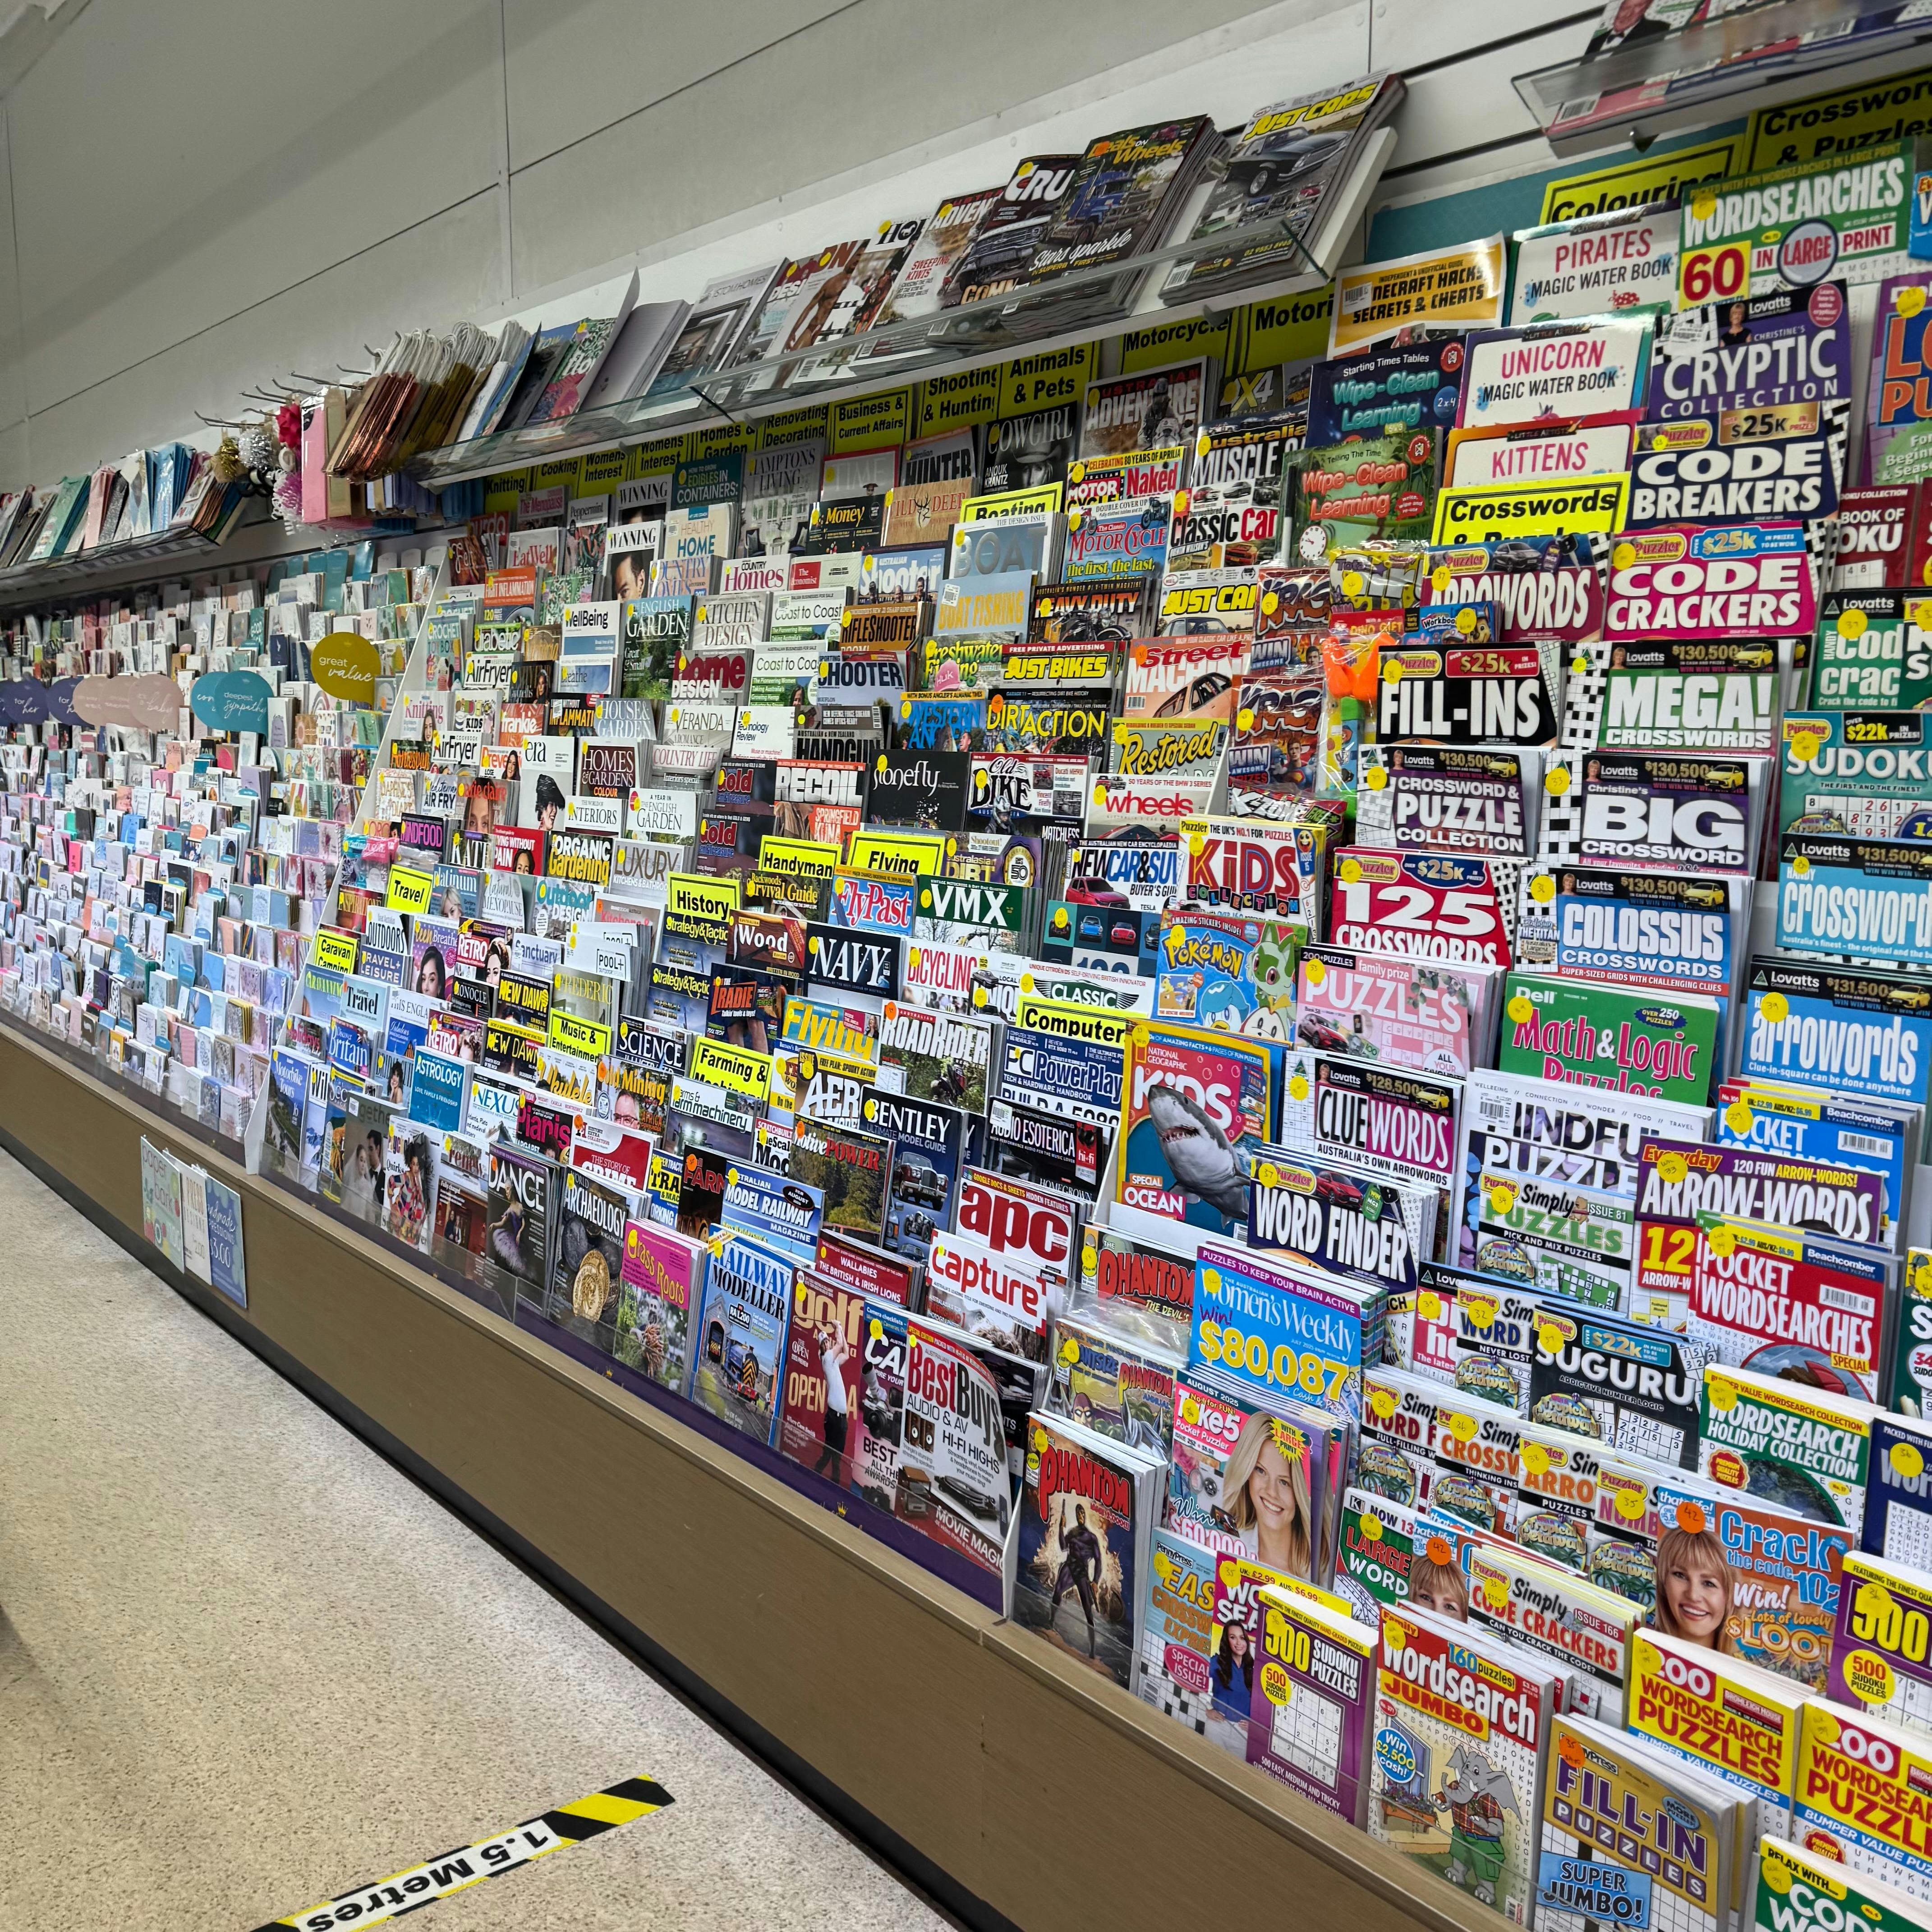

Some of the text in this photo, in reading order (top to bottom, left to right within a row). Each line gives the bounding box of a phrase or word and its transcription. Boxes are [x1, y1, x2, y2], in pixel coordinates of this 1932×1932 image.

[1244, 83, 1378, 140] JUST CARS
[1113, 138, 1186, 165] Wheels
[1685, 161, 1904, 248] WORDSEARCHES
[1555, 229, 1653, 273] PIRATES
[1009, 346, 1085, 378] Animals
[1343, 353, 1430, 378] Starting Times Tables
[1501, 340, 1606, 379] UNICORN
[1663, 329, 1836, 401] CRYPTIC
[1014, 377, 1075, 403] & Pets
[1334, 369, 1440, 405] Wipe-Clean
[1661, 378, 1838, 418] COLLECTION
[839, 397, 902, 420] Business &
[1342, 401, 1420, 432] Learning
[767, 424, 826, 445] Decorating
[839, 419, 903, 439] Current Affairs
[541, 459, 578, 476] Cooking
[584, 463, 622, 483] Interest
[1492, 442, 1588, 478] KITTENS
[1637, 442, 1824, 485] CODE
[487, 477, 525, 494] Knitting
[1127, 463, 1178, 495] Naked
[1302, 460, 1408, 494] Wipe-Clean
[1310, 492, 1389, 520] Learning
[1449, 490, 1616, 523] Crosswords
[1633, 477, 1822, 520] BREAKERS
[681, 520, 714, 535] HEALTHY
[826, 507, 864, 525] Money
[1840, 508, 1905, 524] BOOK OF
[678, 535, 715, 557] HOME
[1612, 558, 1802, 597] CODE
[1607, 592, 1800, 631] CRACKERS
[1843, 598, 1894, 612] Lovatts
[320, 657, 348, 669] great
[1051, 655, 1107, 679] BIKES
[1145, 641, 1245, 668] Street
[1460, 653, 1511, 674] $25k
[328, 667, 373, 682] value
[672, 680, 719, 698] DESIGN
[224, 691, 253, 701] deepest
[1380, 680, 1540, 737] FILL-INS
[1118, 722, 1217, 774] Restored
[1606, 729, 1771, 749] CROSSWORDS
[584, 749, 633, 772] HOMES
[424, 794, 455, 809] AIR FRY
[777, 767, 862, 804] RECOIL
[1105, 791, 1193, 816] wheels
[1398, 794, 1522, 835] PUZZLE
[1181, 821, 1207, 833] Puzzler
[1586, 792, 1745, 850] BIG
[555, 835, 611, 861] ORGANIC
[1397, 827, 1523, 852] COLLECTION
[1581, 839, 1744, 865] CROSSWORD
[764, 851, 832, 878] Handyman
[393, 879, 424, 904] Travel
[677, 890, 729, 921] History
[931, 883, 1009, 927] VMX
[1187, 884, 1299, 918] COLLECTION
[1338, 881, 1495, 936] 125
[739, 925, 788, 952] Wood
[1335, 925, 1497, 965] CROSSWORDS
[1564, 903, 1723, 961] COLOSSUS
[321, 939, 350, 960] Caravan
[810, 937, 892, 986] NAVY
[1562, 950, 1722, 979] CROSSWORDS
[1771, 971, 1820, 987] Lovatts
[347, 985, 378, 1015] Travel
[1052, 983, 1116, 1008] CLASSIC
[561, 1021, 596, 1044] Music &
[620, 1030, 682, 1067] SCIENCE
[700, 1049, 766, 1082] Farming &
[1147, 1055, 1187, 1071] GEOGRAPHIC
[1148, 1046, 1179, 1060] NATIONAL
[415, 1061, 462, 1088] ASTROLOGY
[1748, 1063, 1911, 1096] Clue-in-square can be done anywhere
[1827, 1107, 1895, 1127] Beachcomber
[1023, 1123, 1075, 1157] ESOTERICA
[1132, 1175, 1162, 1187] SPECIAL
[1734, 1159, 1857, 1187] 120 FUN ARROW-WORDS!
[488, 1172, 544, 1212] DANCE
[726, 1185, 813, 1228] MODEL RAILWAY
[1125, 1187, 1183, 1215] OCEAN
[1521, 1184, 1576, 1219] Simply
[563, 1183, 626, 1239] ARCHAEOLOGY
[960, 1185, 1068, 1262] apc
[770, 1223, 811, 1242] MAGAZINE
[1256, 1184, 1407, 1283] WORD FINDER
[1504, 1230, 1601, 1262] PICK AND MIX PUZZLES
[841, 1256, 877, 1279] WALLABIES
[1699, 1273, 1872, 1360] WORDSEARCHES
[1199, 1321, 1348, 1402] $80,087
[1833, 1355, 1868, 1372] SPECIAL
[1187, 1378, 1239, 1407] AUGUST 2025
[1560, 1376, 1664, 1411] ADDICTIVE NUMBER LOGIC
[1708, 1394, 1862, 1461] WORDSEARCH
[863, 1438, 897, 1465] BEST
[943, 1430, 999, 1473] HI-FI HIGHS
[1708, 1418, 1859, 1480] HOLIDAY COLLECTION
[1040, 1444, 1131, 1523] PHANTOM
[1346, 1526, 1412, 1577] LARGE
[1350, 1553, 1408, 1595] WORD
[1513, 1578, 1567, 1620] Simply
[1733, 1582, 1789, 1610] Win!
[1265, 1666, 1286, 1688] 500
[1314, 1643, 1359, 1679] SUDOKU
[1448, 1643, 1516, 1692] 160 puzzles!
[1853, 1656, 1885, 1677] 500
[1311, 1662, 1357, 1699] PUZZLES
[1382, 1633, 1535, 1744] Wordsearch
[1852, 1671, 1885, 1690] SUDOKU
[1386, 1674, 1483, 1734] JUMBO
[1641, 1674, 1782, 1760] WORDSEARCH
[1639, 1697, 1780, 1787] PUZZLES
[1805, 1811, 1904, 1860] BUMPER VALUE
[307, 1831, 549, 1932] 1.5 Metres
[1562, 1860, 1626, 1893] SUPER
[1543, 1881, 1643, 1919] JUMBO!
